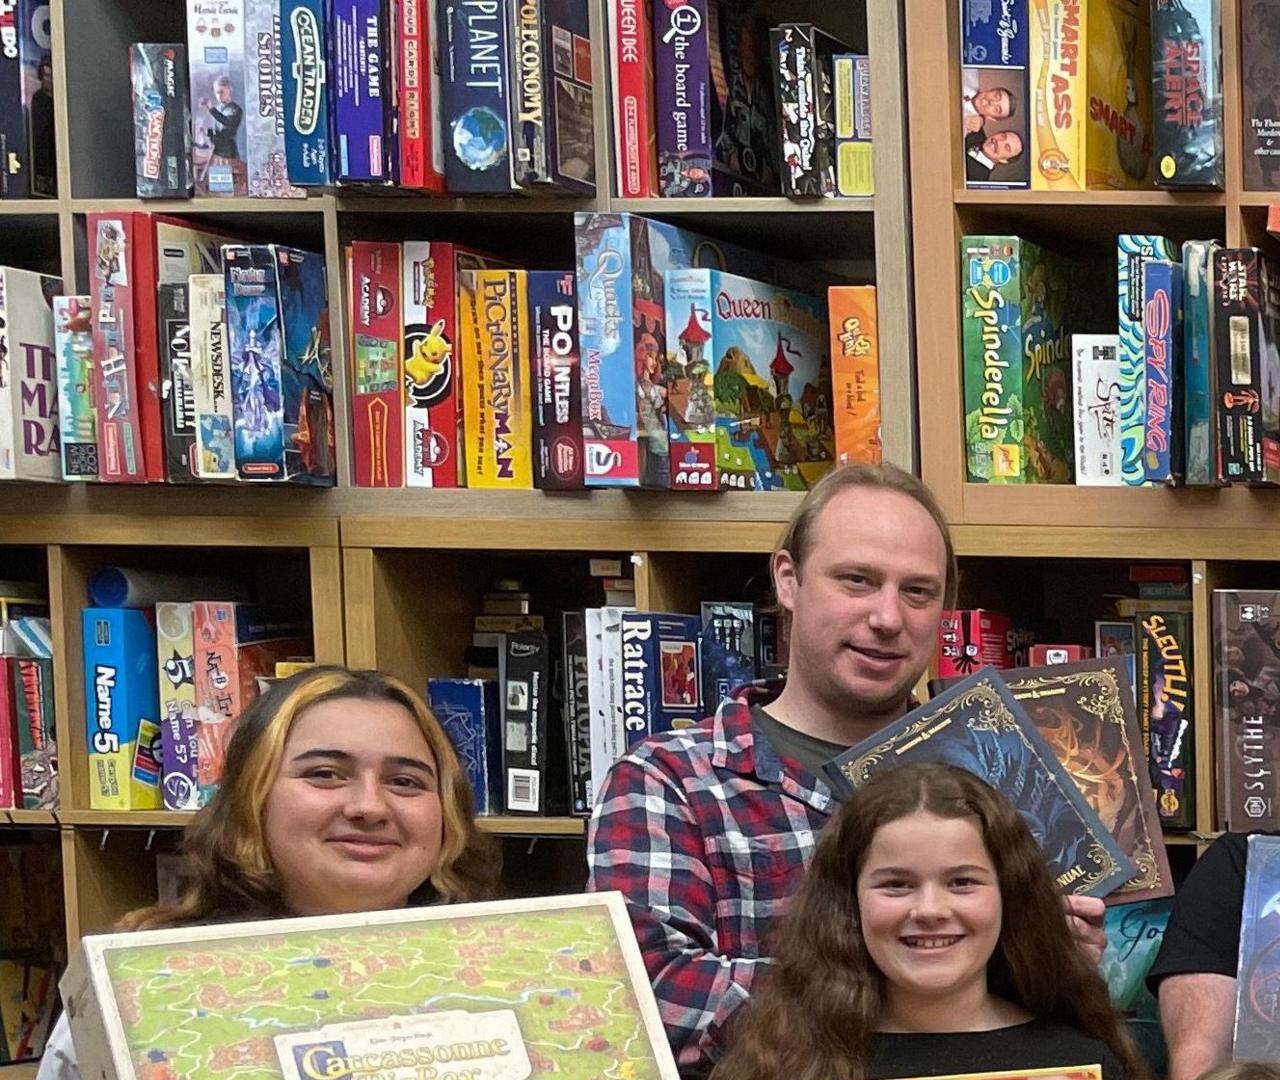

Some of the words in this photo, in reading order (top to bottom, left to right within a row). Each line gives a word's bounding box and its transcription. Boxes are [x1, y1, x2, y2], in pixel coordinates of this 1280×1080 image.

[297, 11, 317, 72] OCEAN
[367, 16, 377, 48] THE
[463, 0, 503, 98] PLANET
[674, 36, 690, 59] the
[367, 51, 380, 98] GAME
[404, 41, 417, 87] CARDS
[674, 62, 691, 107] board
[300, 74, 318, 128] TRADER
[405, 91, 419, 138] RIGHT
[1050, 74, 1072, 129] ASS
[673, 111, 688, 151] game
[716, 291, 772, 321] Queen
[588, 350, 605, 421] MegaBox
[969, 287, 1009, 440] Spinderella
[95, 665, 116, 728] Name
[622, 617, 652, 732] Ratrace
[94, 732, 119, 755] 5
[1242, 714, 1271, 791] SCYTHE
